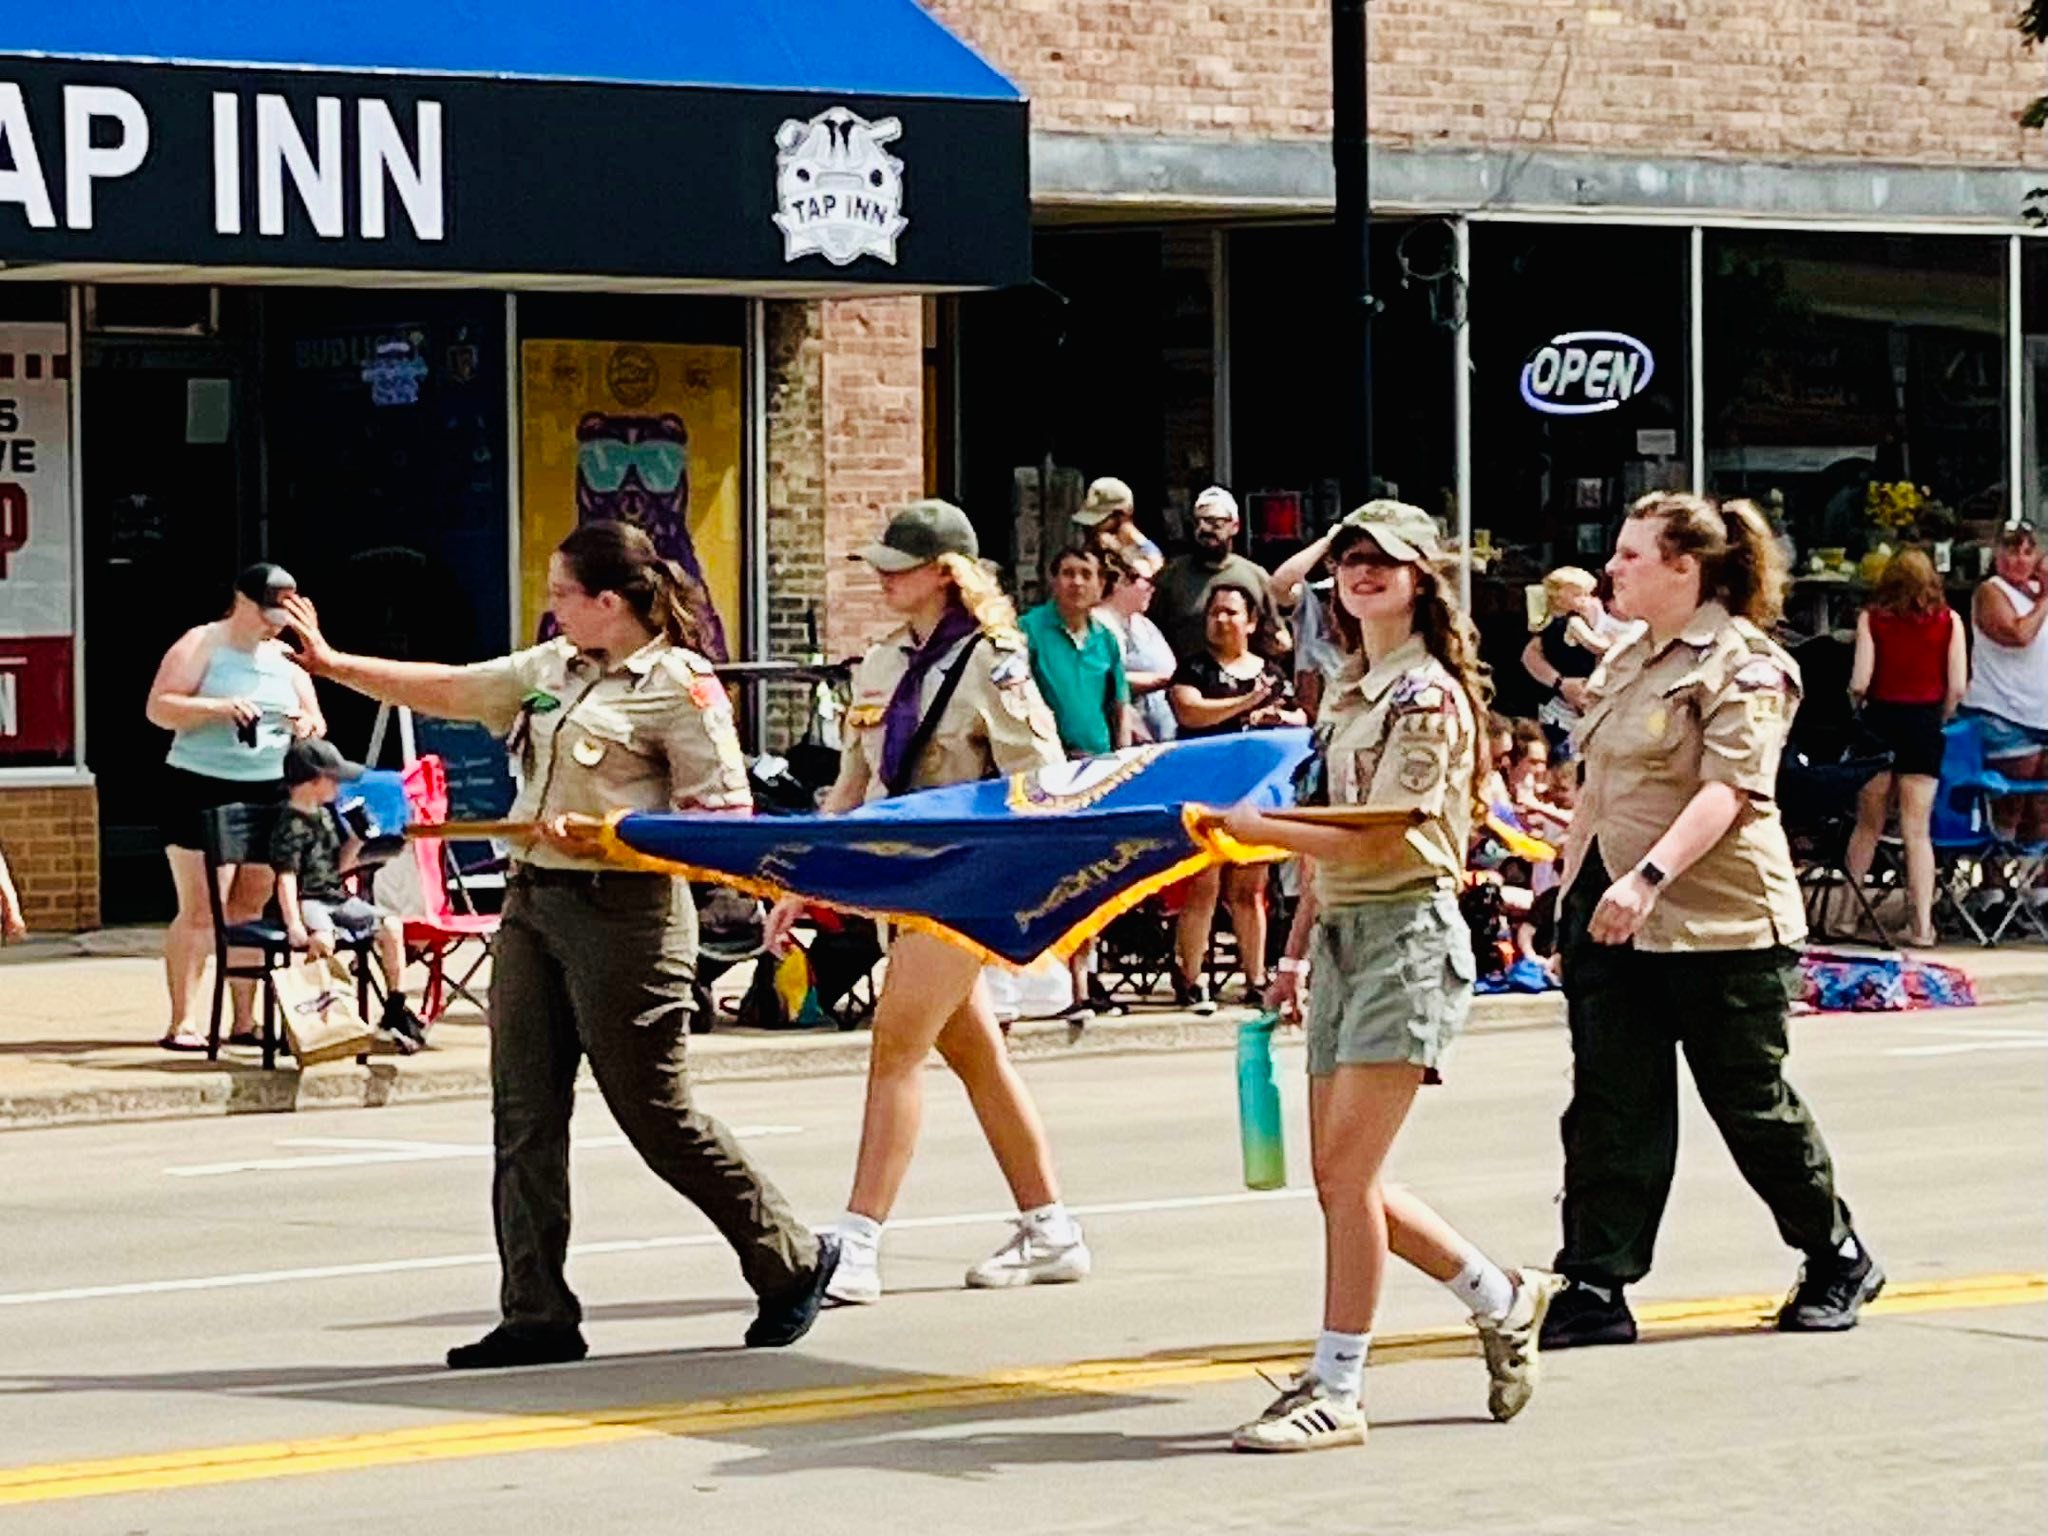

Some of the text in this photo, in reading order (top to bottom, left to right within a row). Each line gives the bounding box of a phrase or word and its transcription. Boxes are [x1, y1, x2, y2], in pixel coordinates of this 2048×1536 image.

[212, 91, 443, 241] INN
[791, 194, 888, 227] TAP INN
[1532, 346, 1640, 401] OPEN
